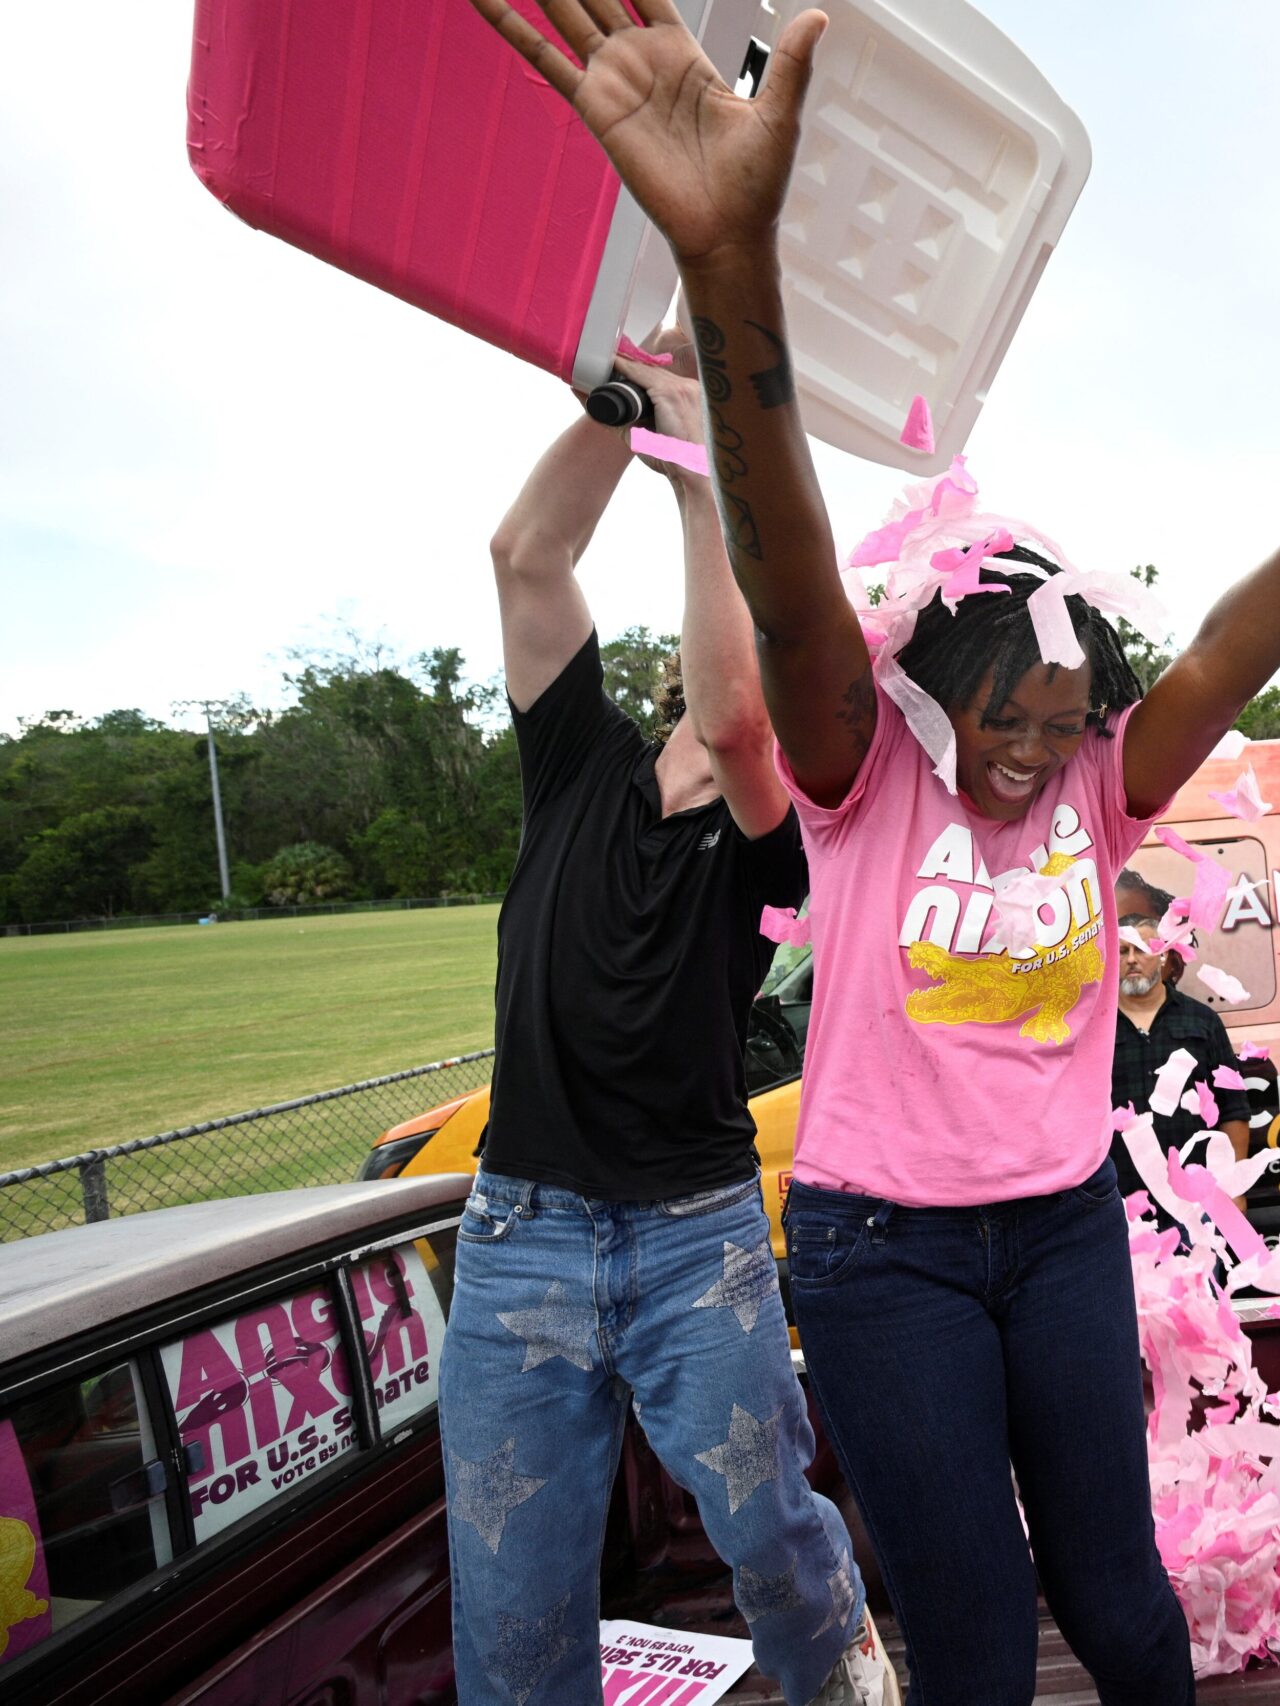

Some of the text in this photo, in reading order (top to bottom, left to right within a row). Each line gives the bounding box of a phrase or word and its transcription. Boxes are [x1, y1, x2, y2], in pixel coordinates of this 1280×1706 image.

[1012, 958, 1043, 974] FOR
[1046, 946, 1071, 964] U.S.
[191, 1460, 261, 1519] FOR
[267, 1426, 328, 1472] U.S.
[616, 1635, 627, 1644] 3
[640, 1651, 682, 1672] U.S.
[678, 1658, 728, 1680] FOR
